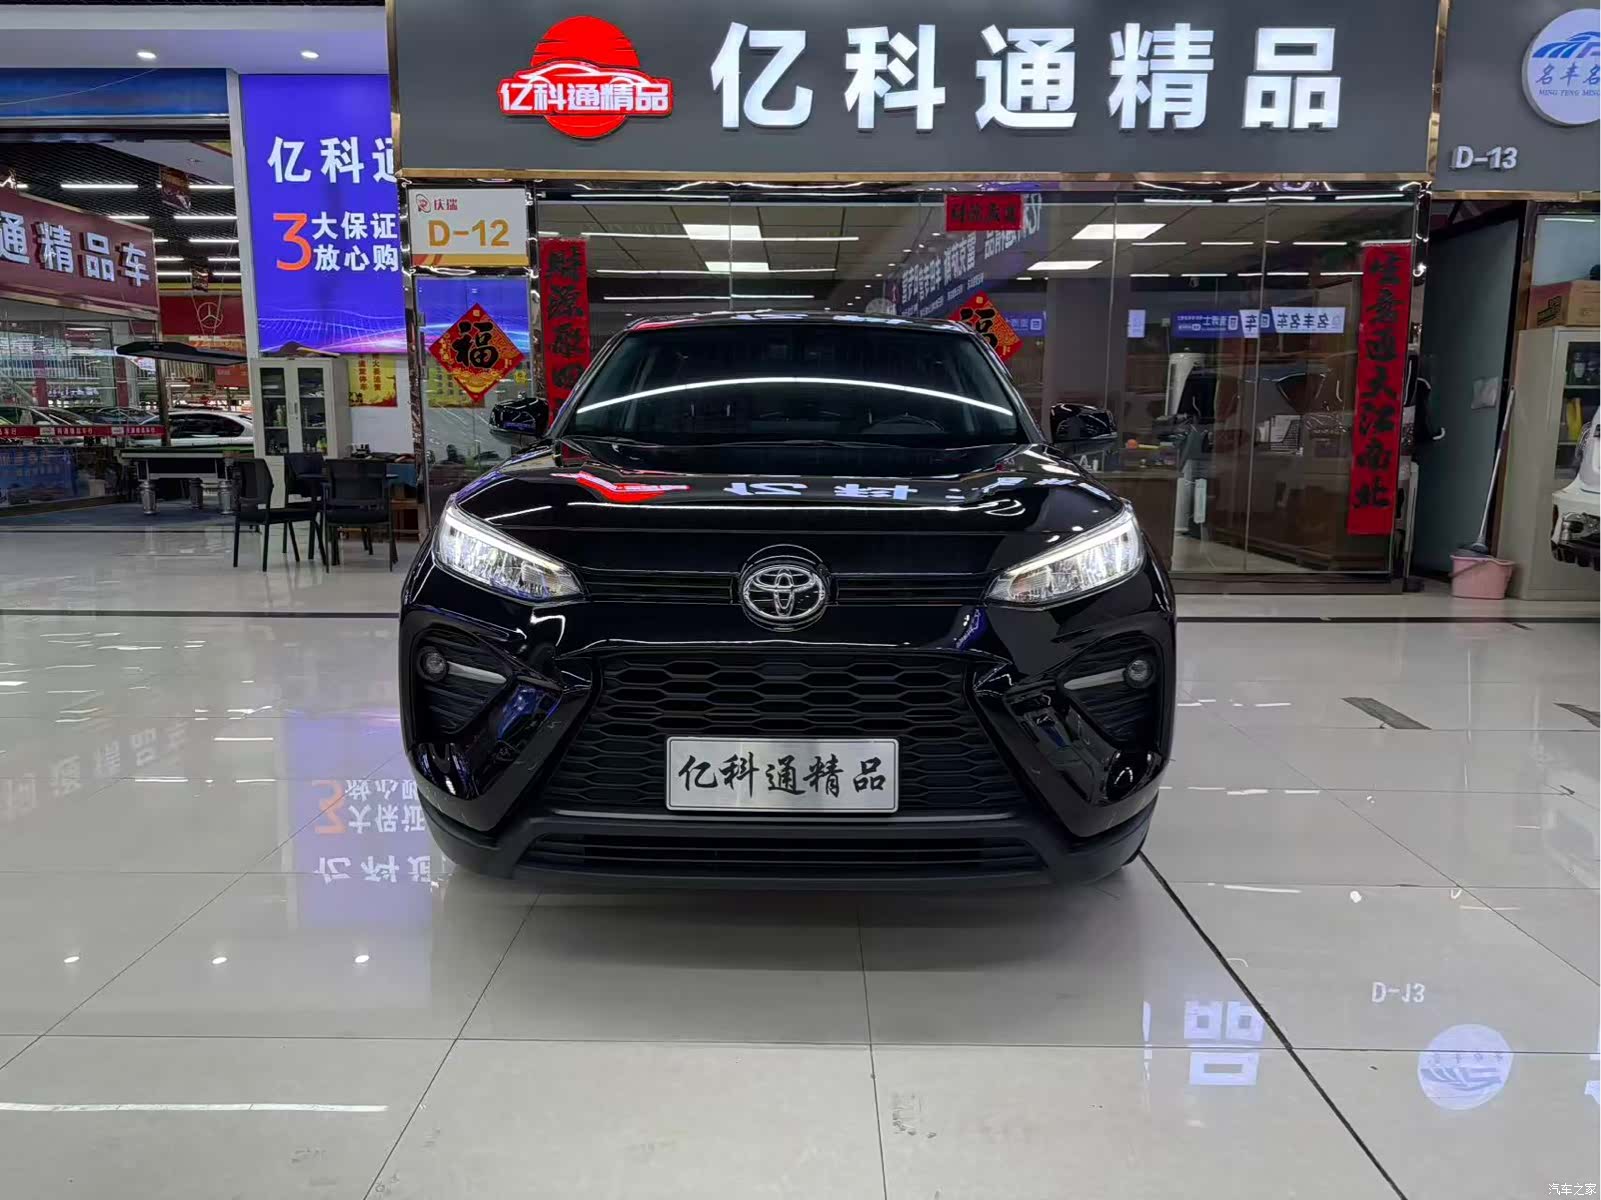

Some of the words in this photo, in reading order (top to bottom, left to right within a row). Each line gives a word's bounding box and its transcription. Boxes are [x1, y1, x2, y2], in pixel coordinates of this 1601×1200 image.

[710, 22, 1341, 131] 亿科通精品
[499, 83, 669, 112] 亿科通精品
[1453, 145, 1518, 170] D-13
[434, 198, 458, 211] 庆瑞
[273, 213, 312, 271] 3
[312, 211, 398, 241] 大保证
[428, 219, 511, 248] D-12
[314, 244, 399, 273] 放心购
[451, 320, 500, 369] 福
[678, 751, 887, 798] 亿科通精品
